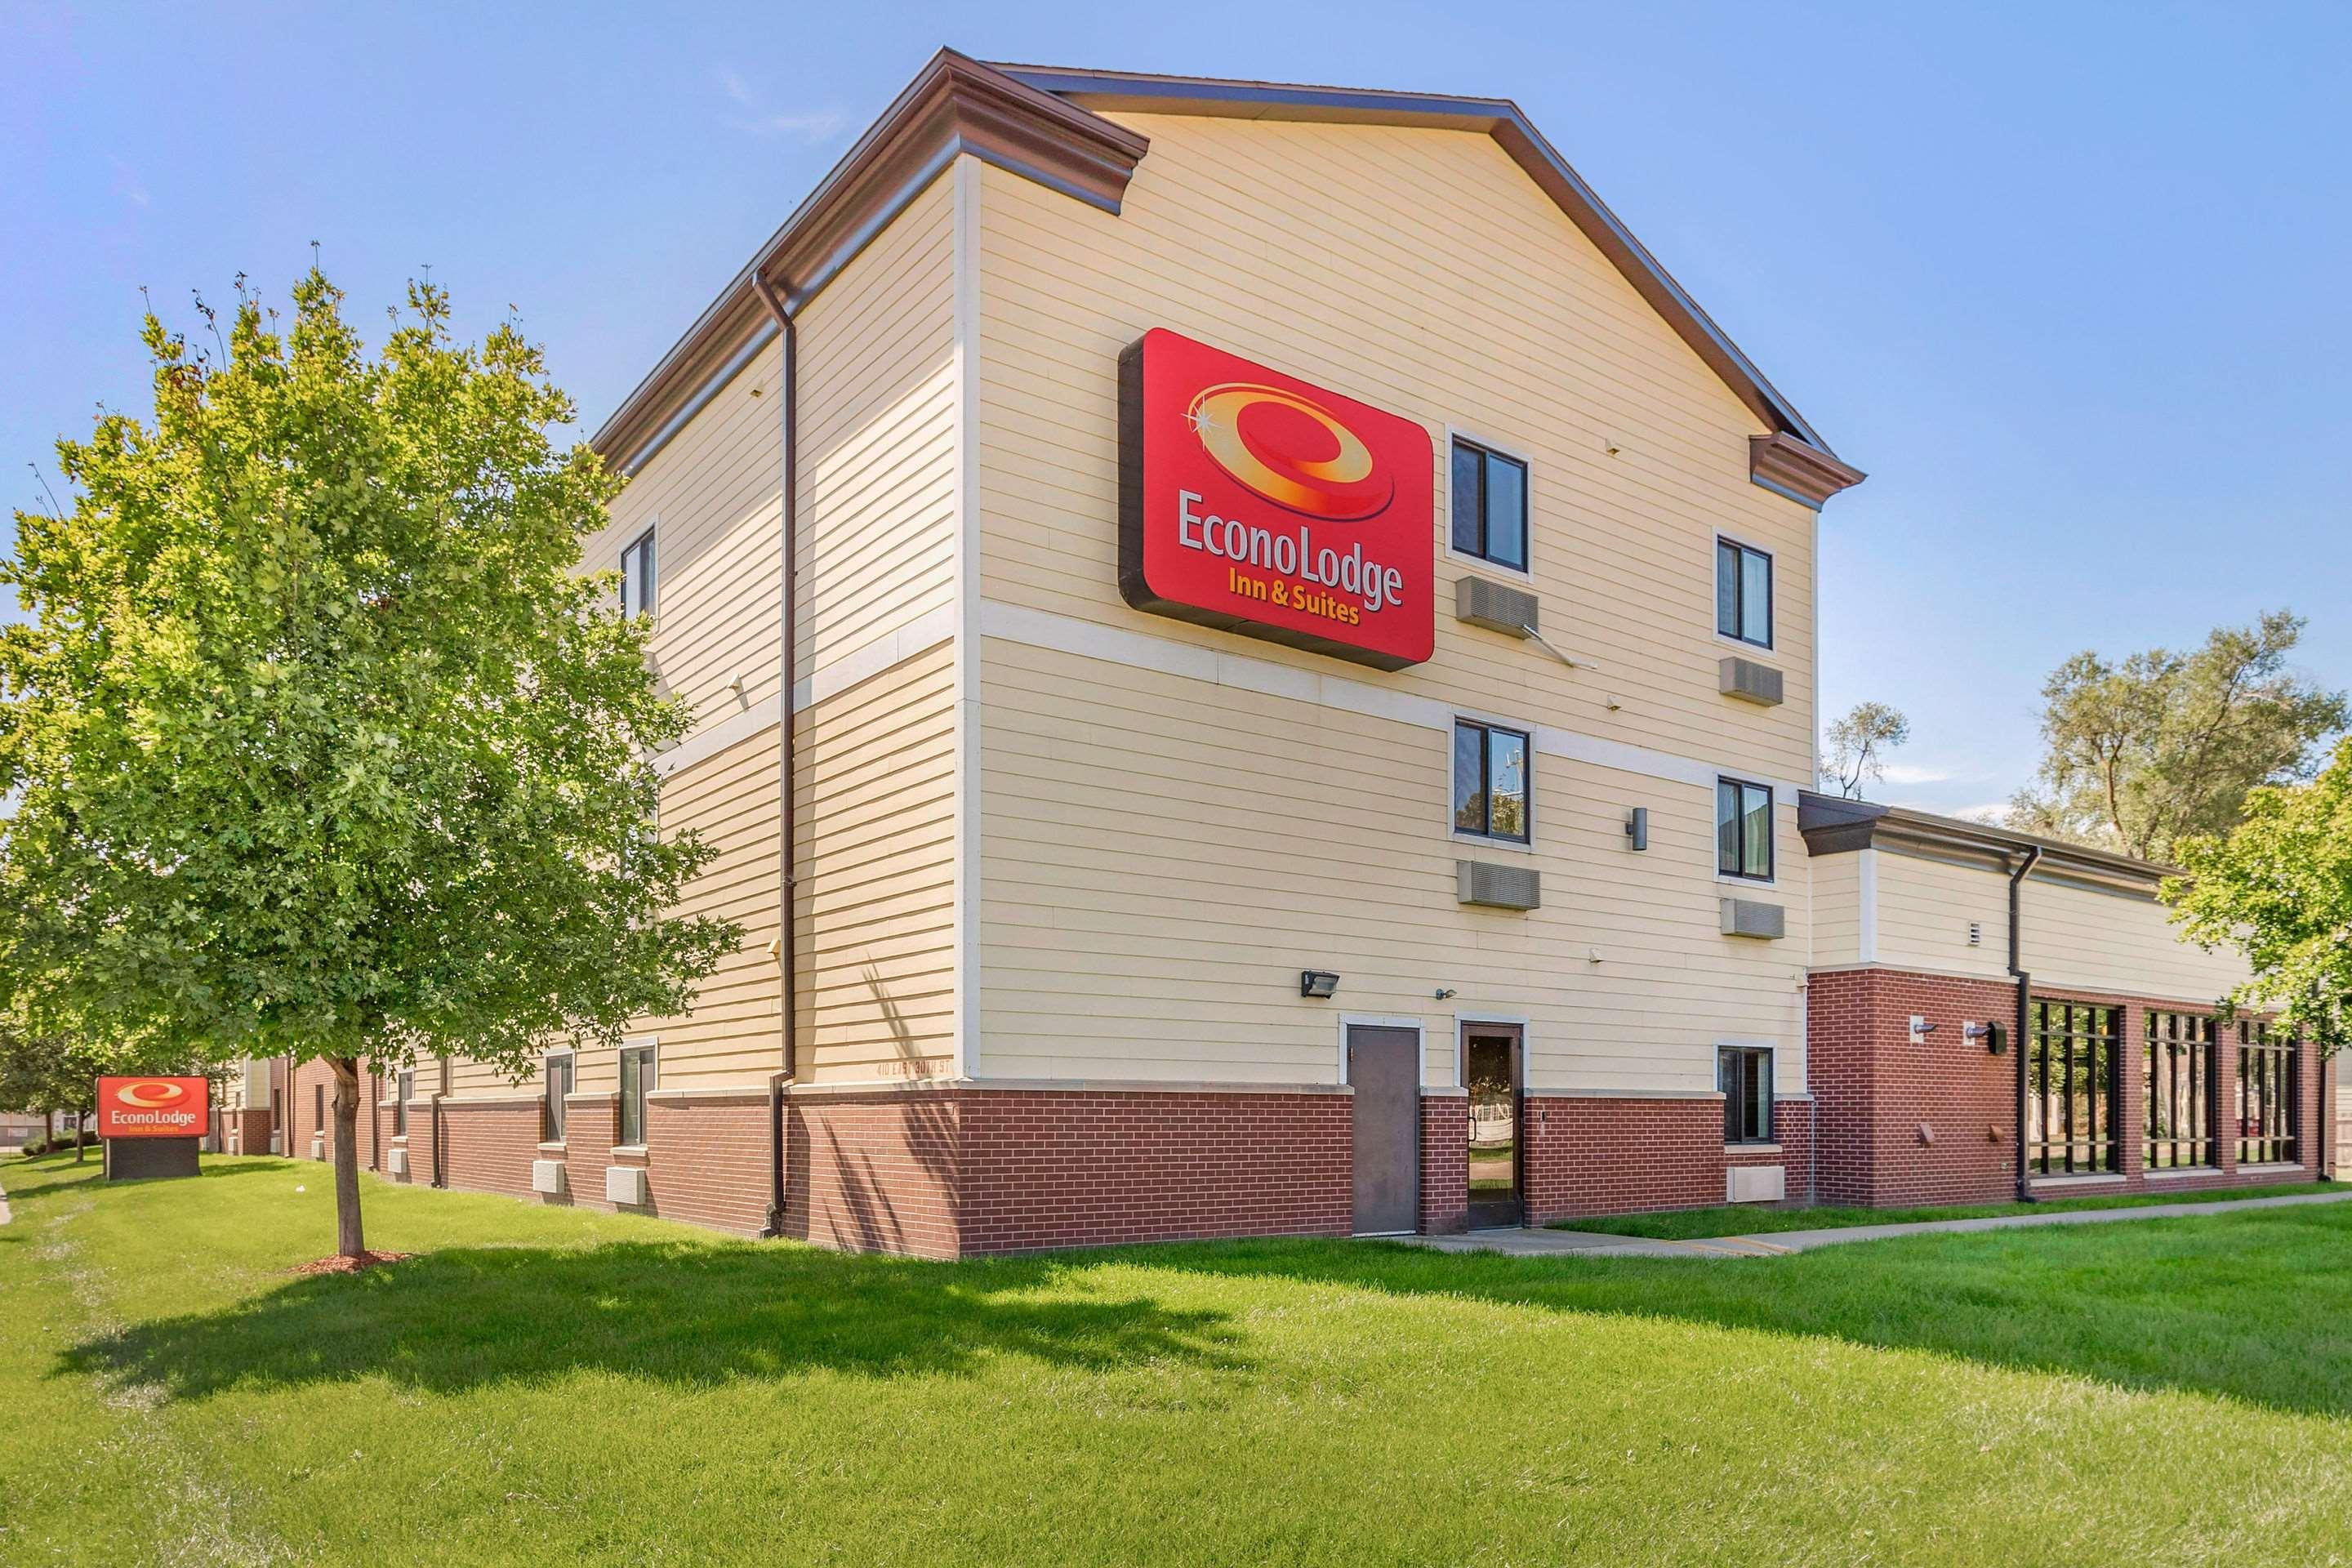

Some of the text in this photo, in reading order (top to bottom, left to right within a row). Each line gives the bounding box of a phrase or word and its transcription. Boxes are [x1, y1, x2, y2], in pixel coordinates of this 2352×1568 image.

[1178, 488, 1404, 612] EconoLodge
[1229, 568, 1361, 626] Inn & Suites
[111, 1111, 196, 1126] EconoLodge
